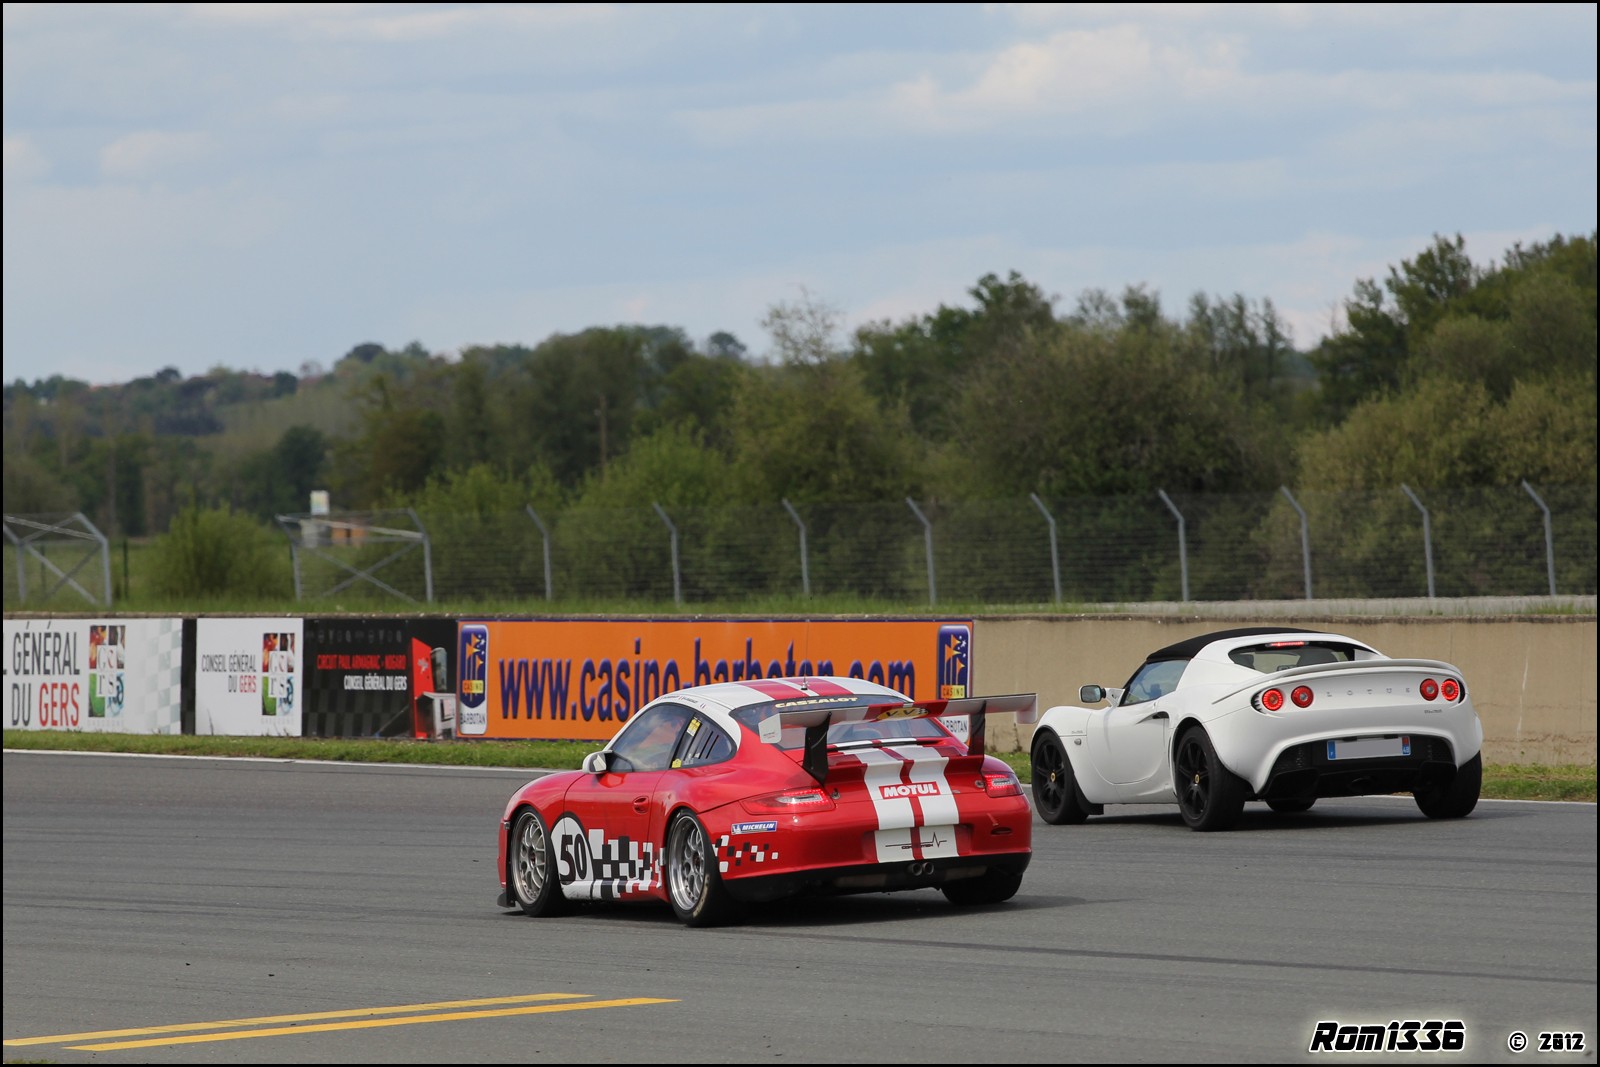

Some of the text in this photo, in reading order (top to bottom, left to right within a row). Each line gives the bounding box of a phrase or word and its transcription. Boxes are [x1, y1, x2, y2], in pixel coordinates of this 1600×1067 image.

[13, 621, 80, 675] GÉNÉRAL
[202, 650, 256, 672] CONSEIL GÉNÉRAL
[338, 654, 351, 669] PAUL
[228, 675, 256, 692] DU GERS
[344, 673, 407, 690] CONSEIL GÉNÉRAL DU GERS
[498, 637, 915, 721] www.casino-bbm
[943, 687, 964, 697] CASINO
[1326, 687, 1411, 697] LOTUS
[12, 683, 79, 726] DU GERS
[775, 697, 858, 709] CASZALOT
[941, 719, 968, 732] RBOTAN
[884, 783, 937, 798] MOTUL
[742, 823, 774, 831] MICHELIN
[560, 833, 588, 885] 50
